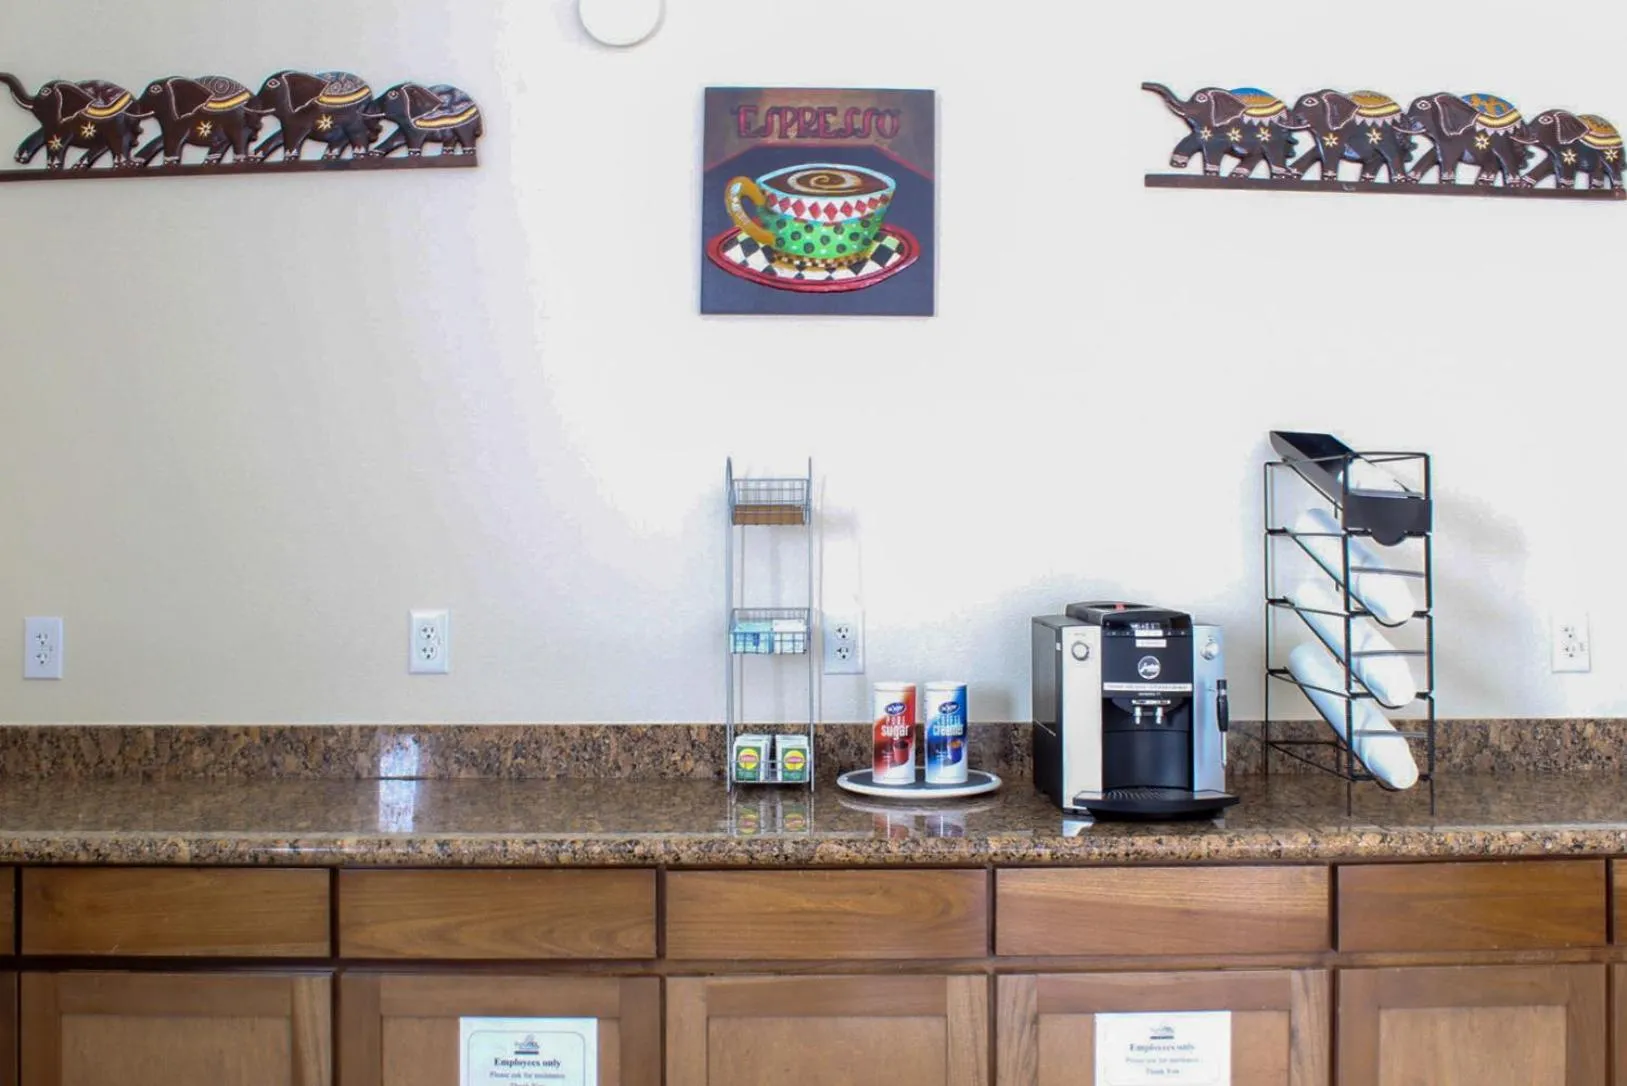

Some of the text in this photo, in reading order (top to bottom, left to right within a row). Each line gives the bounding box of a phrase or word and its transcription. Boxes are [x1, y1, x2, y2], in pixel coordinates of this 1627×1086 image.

[733, 105, 902, 139] ESPRESSO
[881, 725, 910, 740] sugar
[494, 1057, 561, 1068] Employees only
